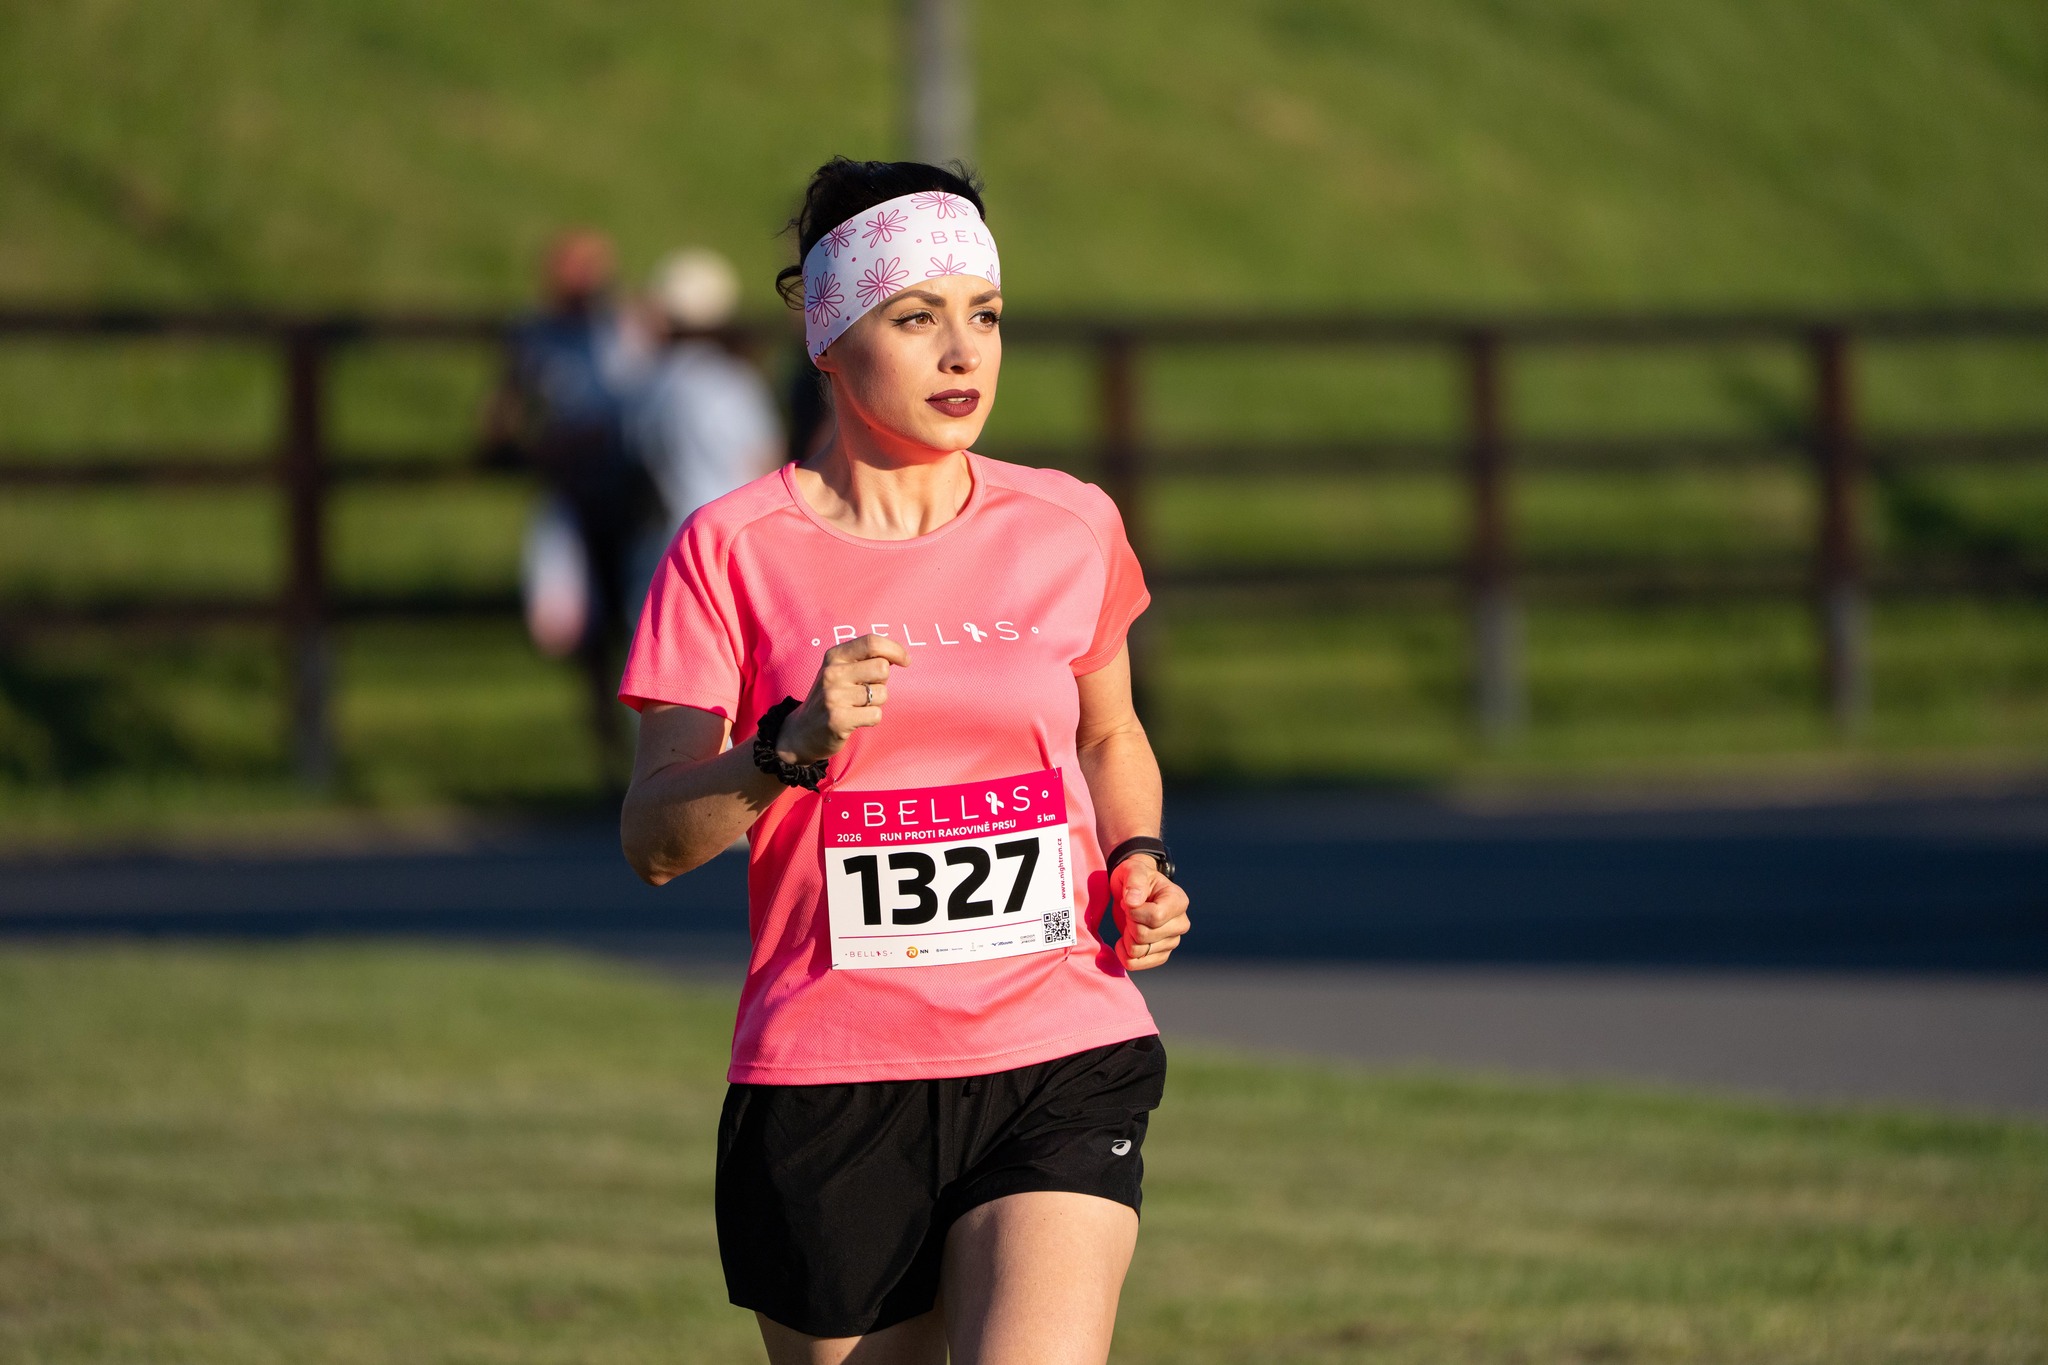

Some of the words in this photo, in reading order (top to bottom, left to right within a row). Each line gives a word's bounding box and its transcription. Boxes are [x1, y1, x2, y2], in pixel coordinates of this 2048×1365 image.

[1037, 815, 1043, 823] 5
[1043, 812, 1056, 822] km
[837, 833, 862, 843] 2026
[880, 832, 903, 842] RUN
[904, 829, 936, 841] PROTI
[938, 821, 990, 838] RAKOVINĚ
[992, 819, 1017, 831] PRSU
[843, 836, 1040, 925] 1327
[1058, 838, 1067, 900] www.nightrun.cz
